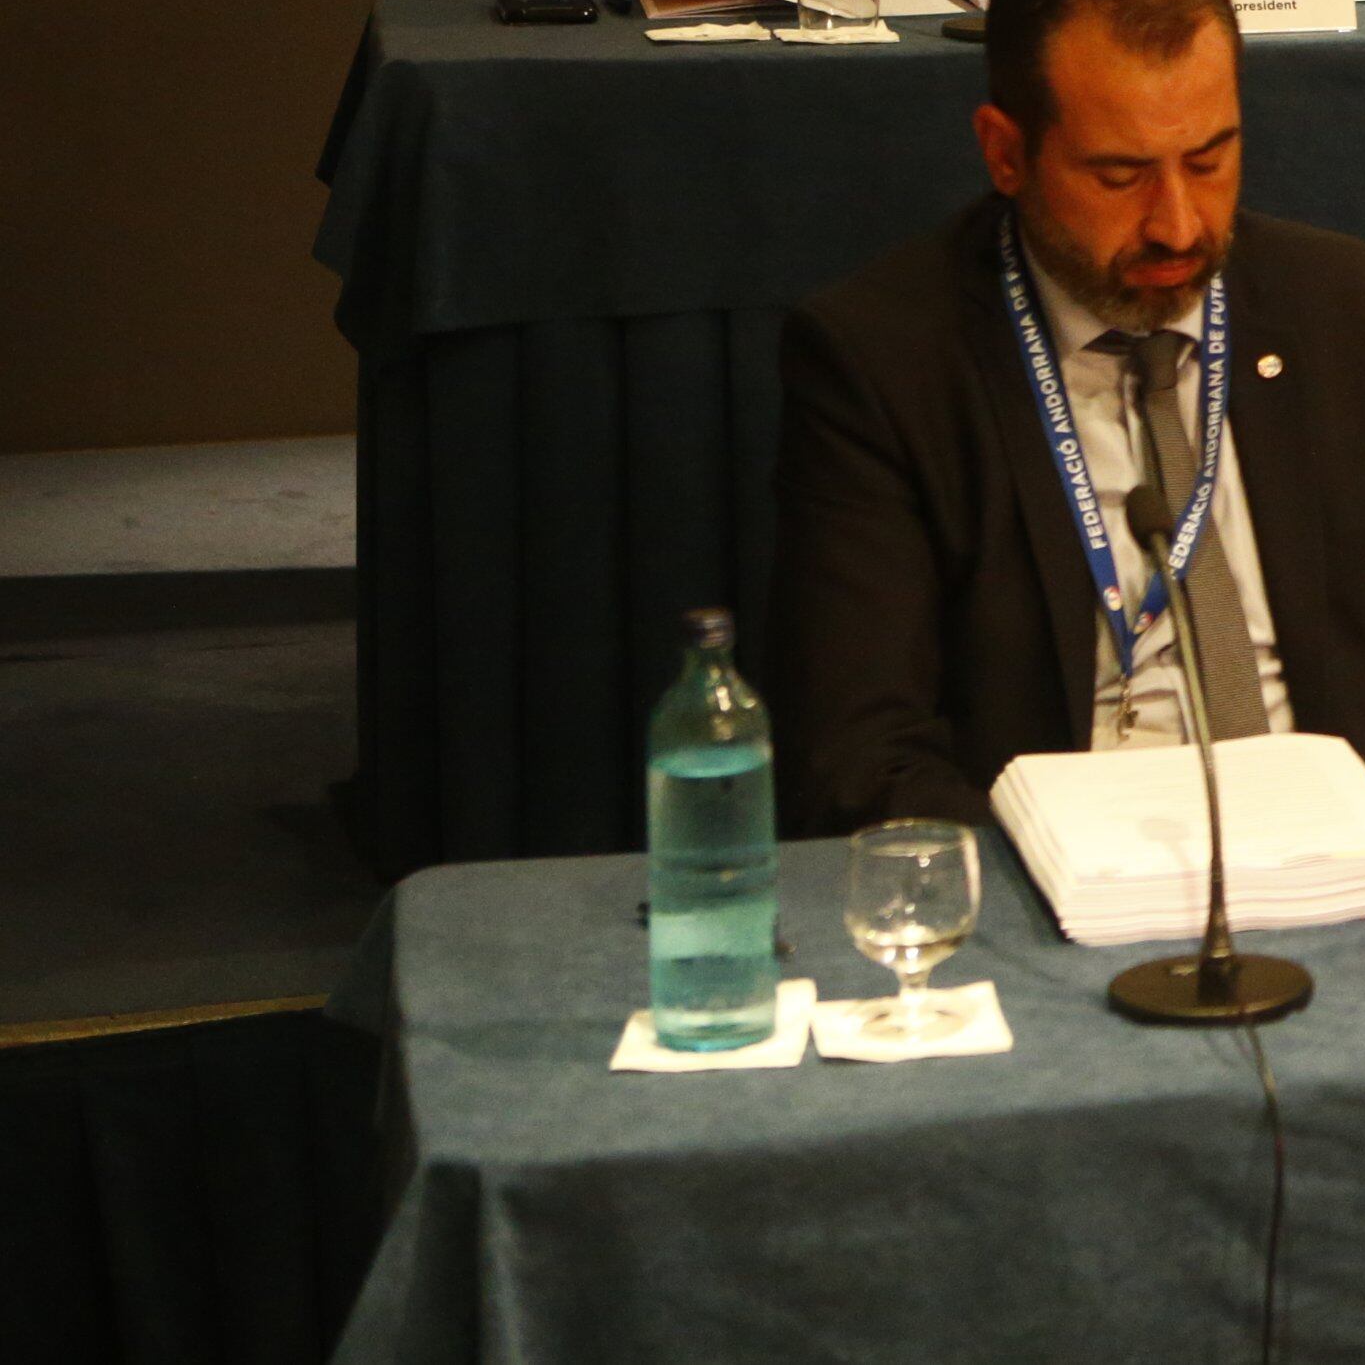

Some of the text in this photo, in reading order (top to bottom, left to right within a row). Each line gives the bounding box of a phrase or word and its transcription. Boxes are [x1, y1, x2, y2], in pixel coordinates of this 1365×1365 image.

[1234, 0, 1298, 12] president
[1009, 284, 1028, 312] DE
[1020, 313, 1073, 434] ANDORRANA
[1208, 329, 1226, 354] DE
[1203, 358, 1225, 478] ANDORRANA
[1056, 437, 1108, 550] FEDERACIÓ
